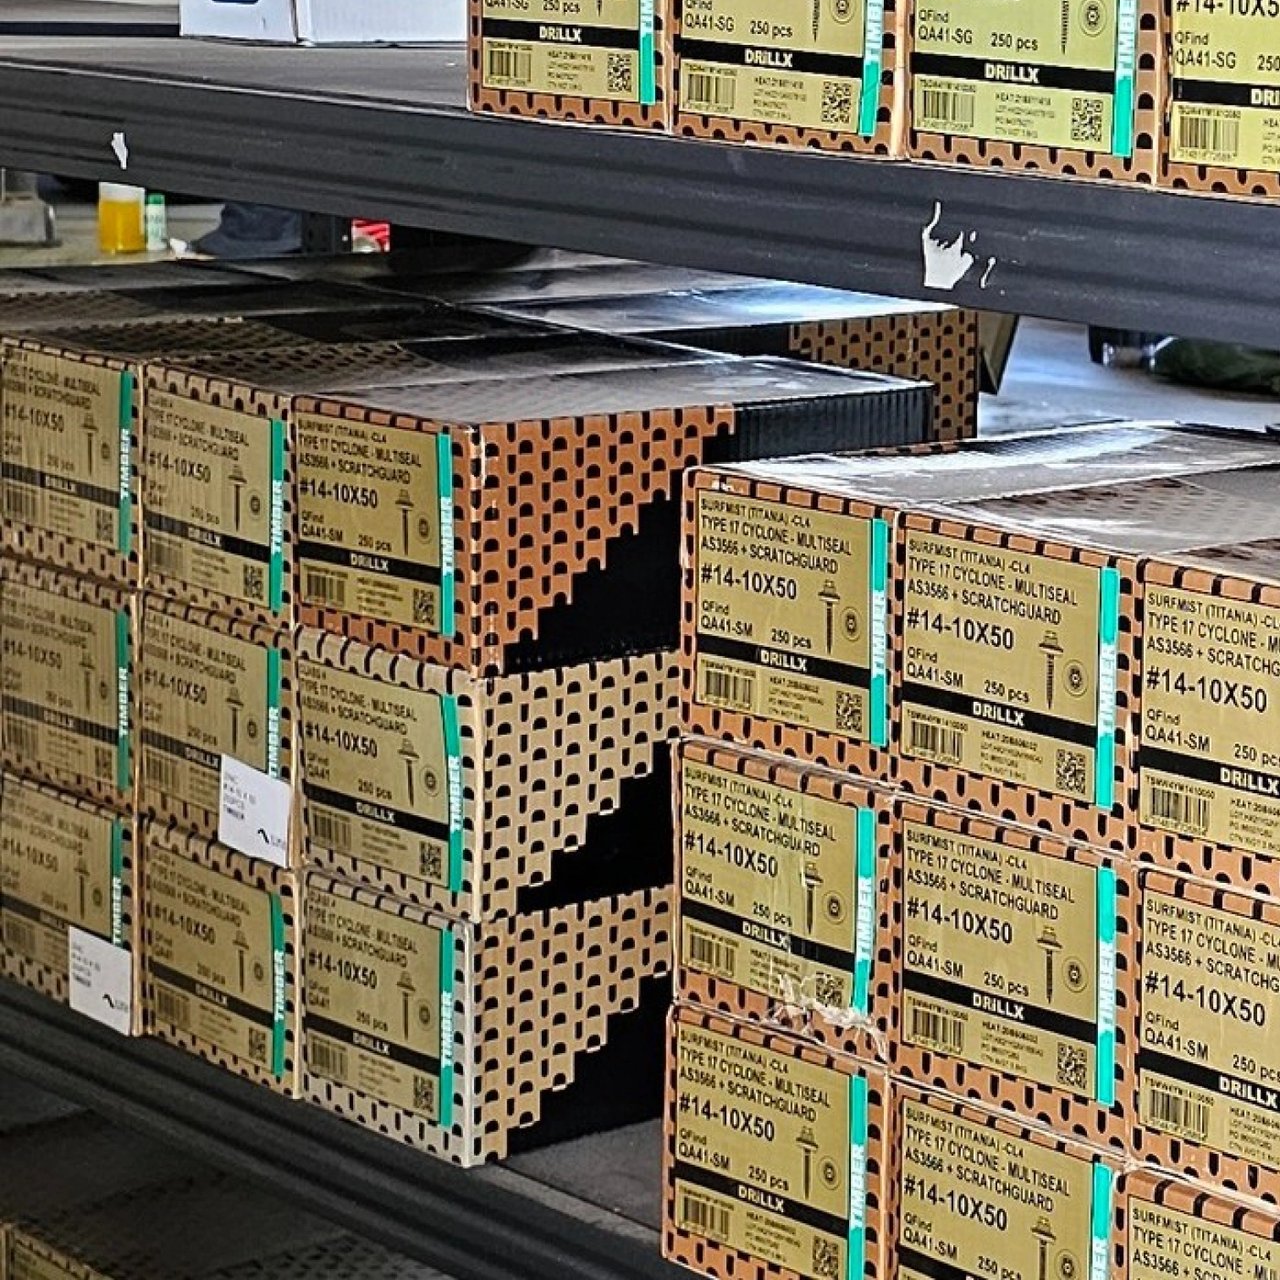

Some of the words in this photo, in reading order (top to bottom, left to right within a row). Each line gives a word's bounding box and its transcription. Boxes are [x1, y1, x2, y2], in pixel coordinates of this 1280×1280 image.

[919, 25, 973, 46] QA41-SG
[272, 480, 283, 553] TIMBER
[300, 477, 378, 509] #14-10X50
[358, 534, 373, 548] 250
[375, 539, 392, 552] pcs
[702, 561, 797, 601] #14-10X50
[907, 605, 1014, 651] #14-10X50
[118, 667, 129, 738] TIMBER
[1146, 664, 1267, 713] #14-10X50
[269, 706, 280, 779] TIMBER
[305, 722, 378, 759] #14-10X50
[449, 755, 462, 832] TIMBER
[685, 829, 778, 878] #14-10X50
[907, 894, 1012, 945] #14-10X50
[274, 950, 285, 1022] TIMBER
[1146, 968, 1266, 1028] #14-10X50
[441, 991, 453, 1066] TIMBER
[1145, 1026, 1208, 1062] QA41-SM
[680, 1090, 774, 1142] #14-10X50
[904, 1172, 1007, 1232] #14-10X50
